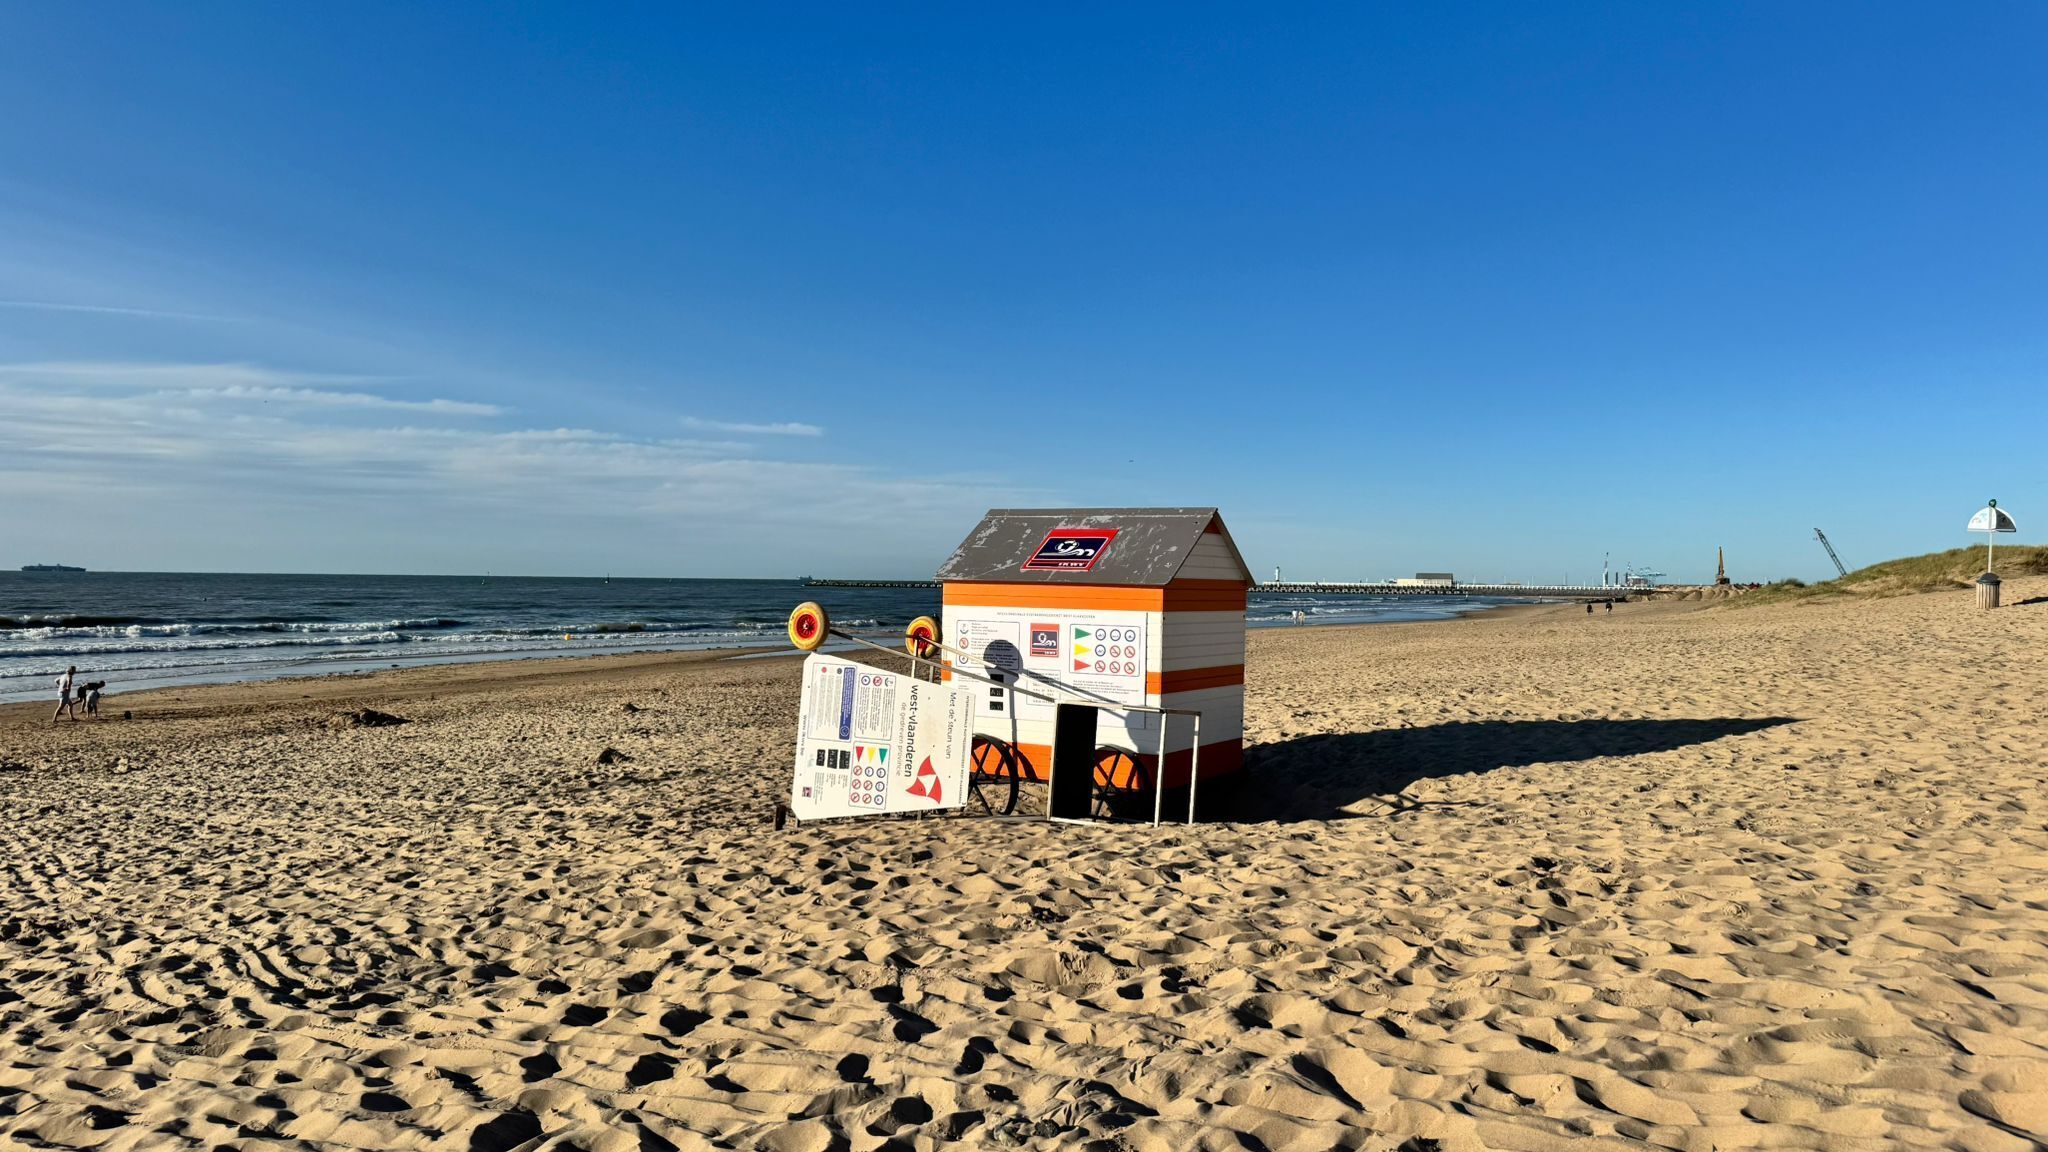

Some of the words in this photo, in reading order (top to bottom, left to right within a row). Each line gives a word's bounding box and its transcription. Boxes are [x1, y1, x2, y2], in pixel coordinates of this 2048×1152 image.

[948, 710, 956, 719] de
[949, 692, 957, 706] Met
[898, 712, 906, 744] gedreven
[904, 685, 919, 778] west-vlaanderen
[896, 745, 904, 776] provincie
